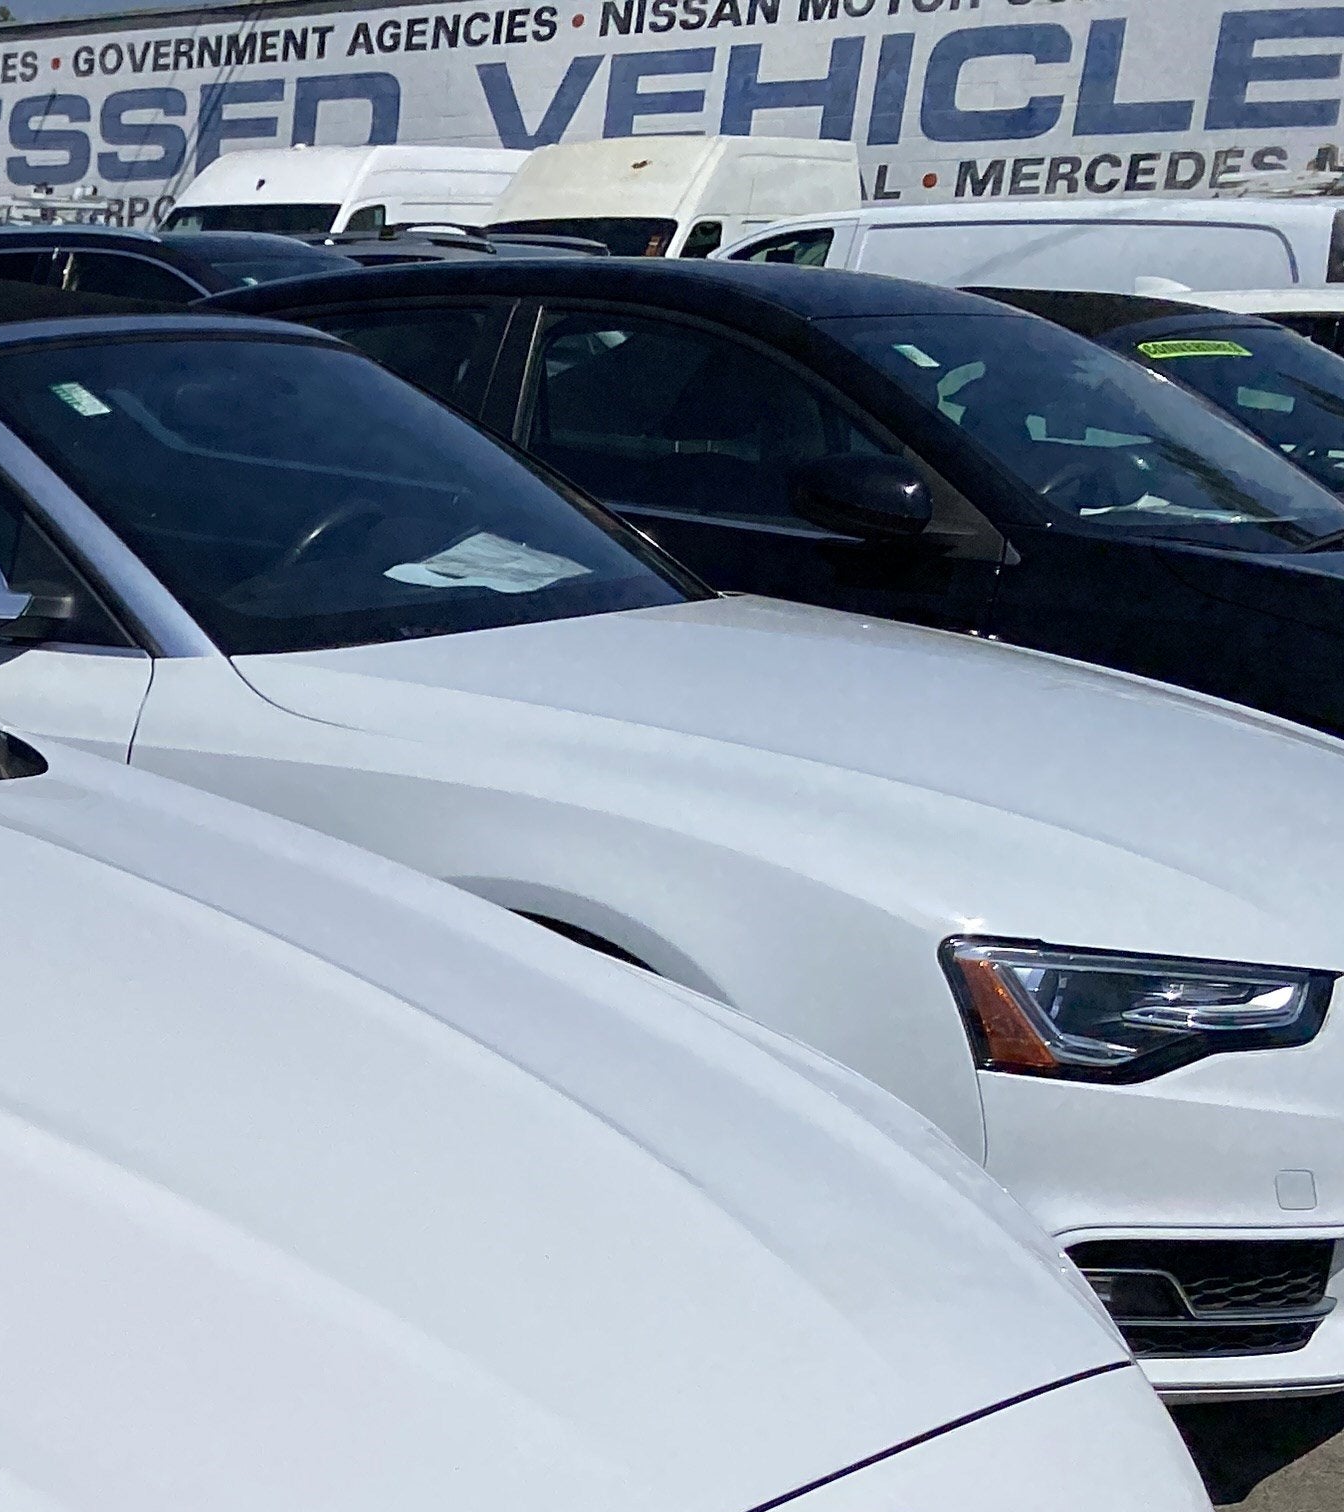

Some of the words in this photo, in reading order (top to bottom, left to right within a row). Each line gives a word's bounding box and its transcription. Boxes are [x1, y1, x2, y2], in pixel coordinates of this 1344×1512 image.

[72, 24, 334, 77] GOVERNMENT
[346, 6, 558, 57] AGENCIES
[599, 0, 780, 37] NISSAN
[954, 146, 1289, 198] MERCEDES
